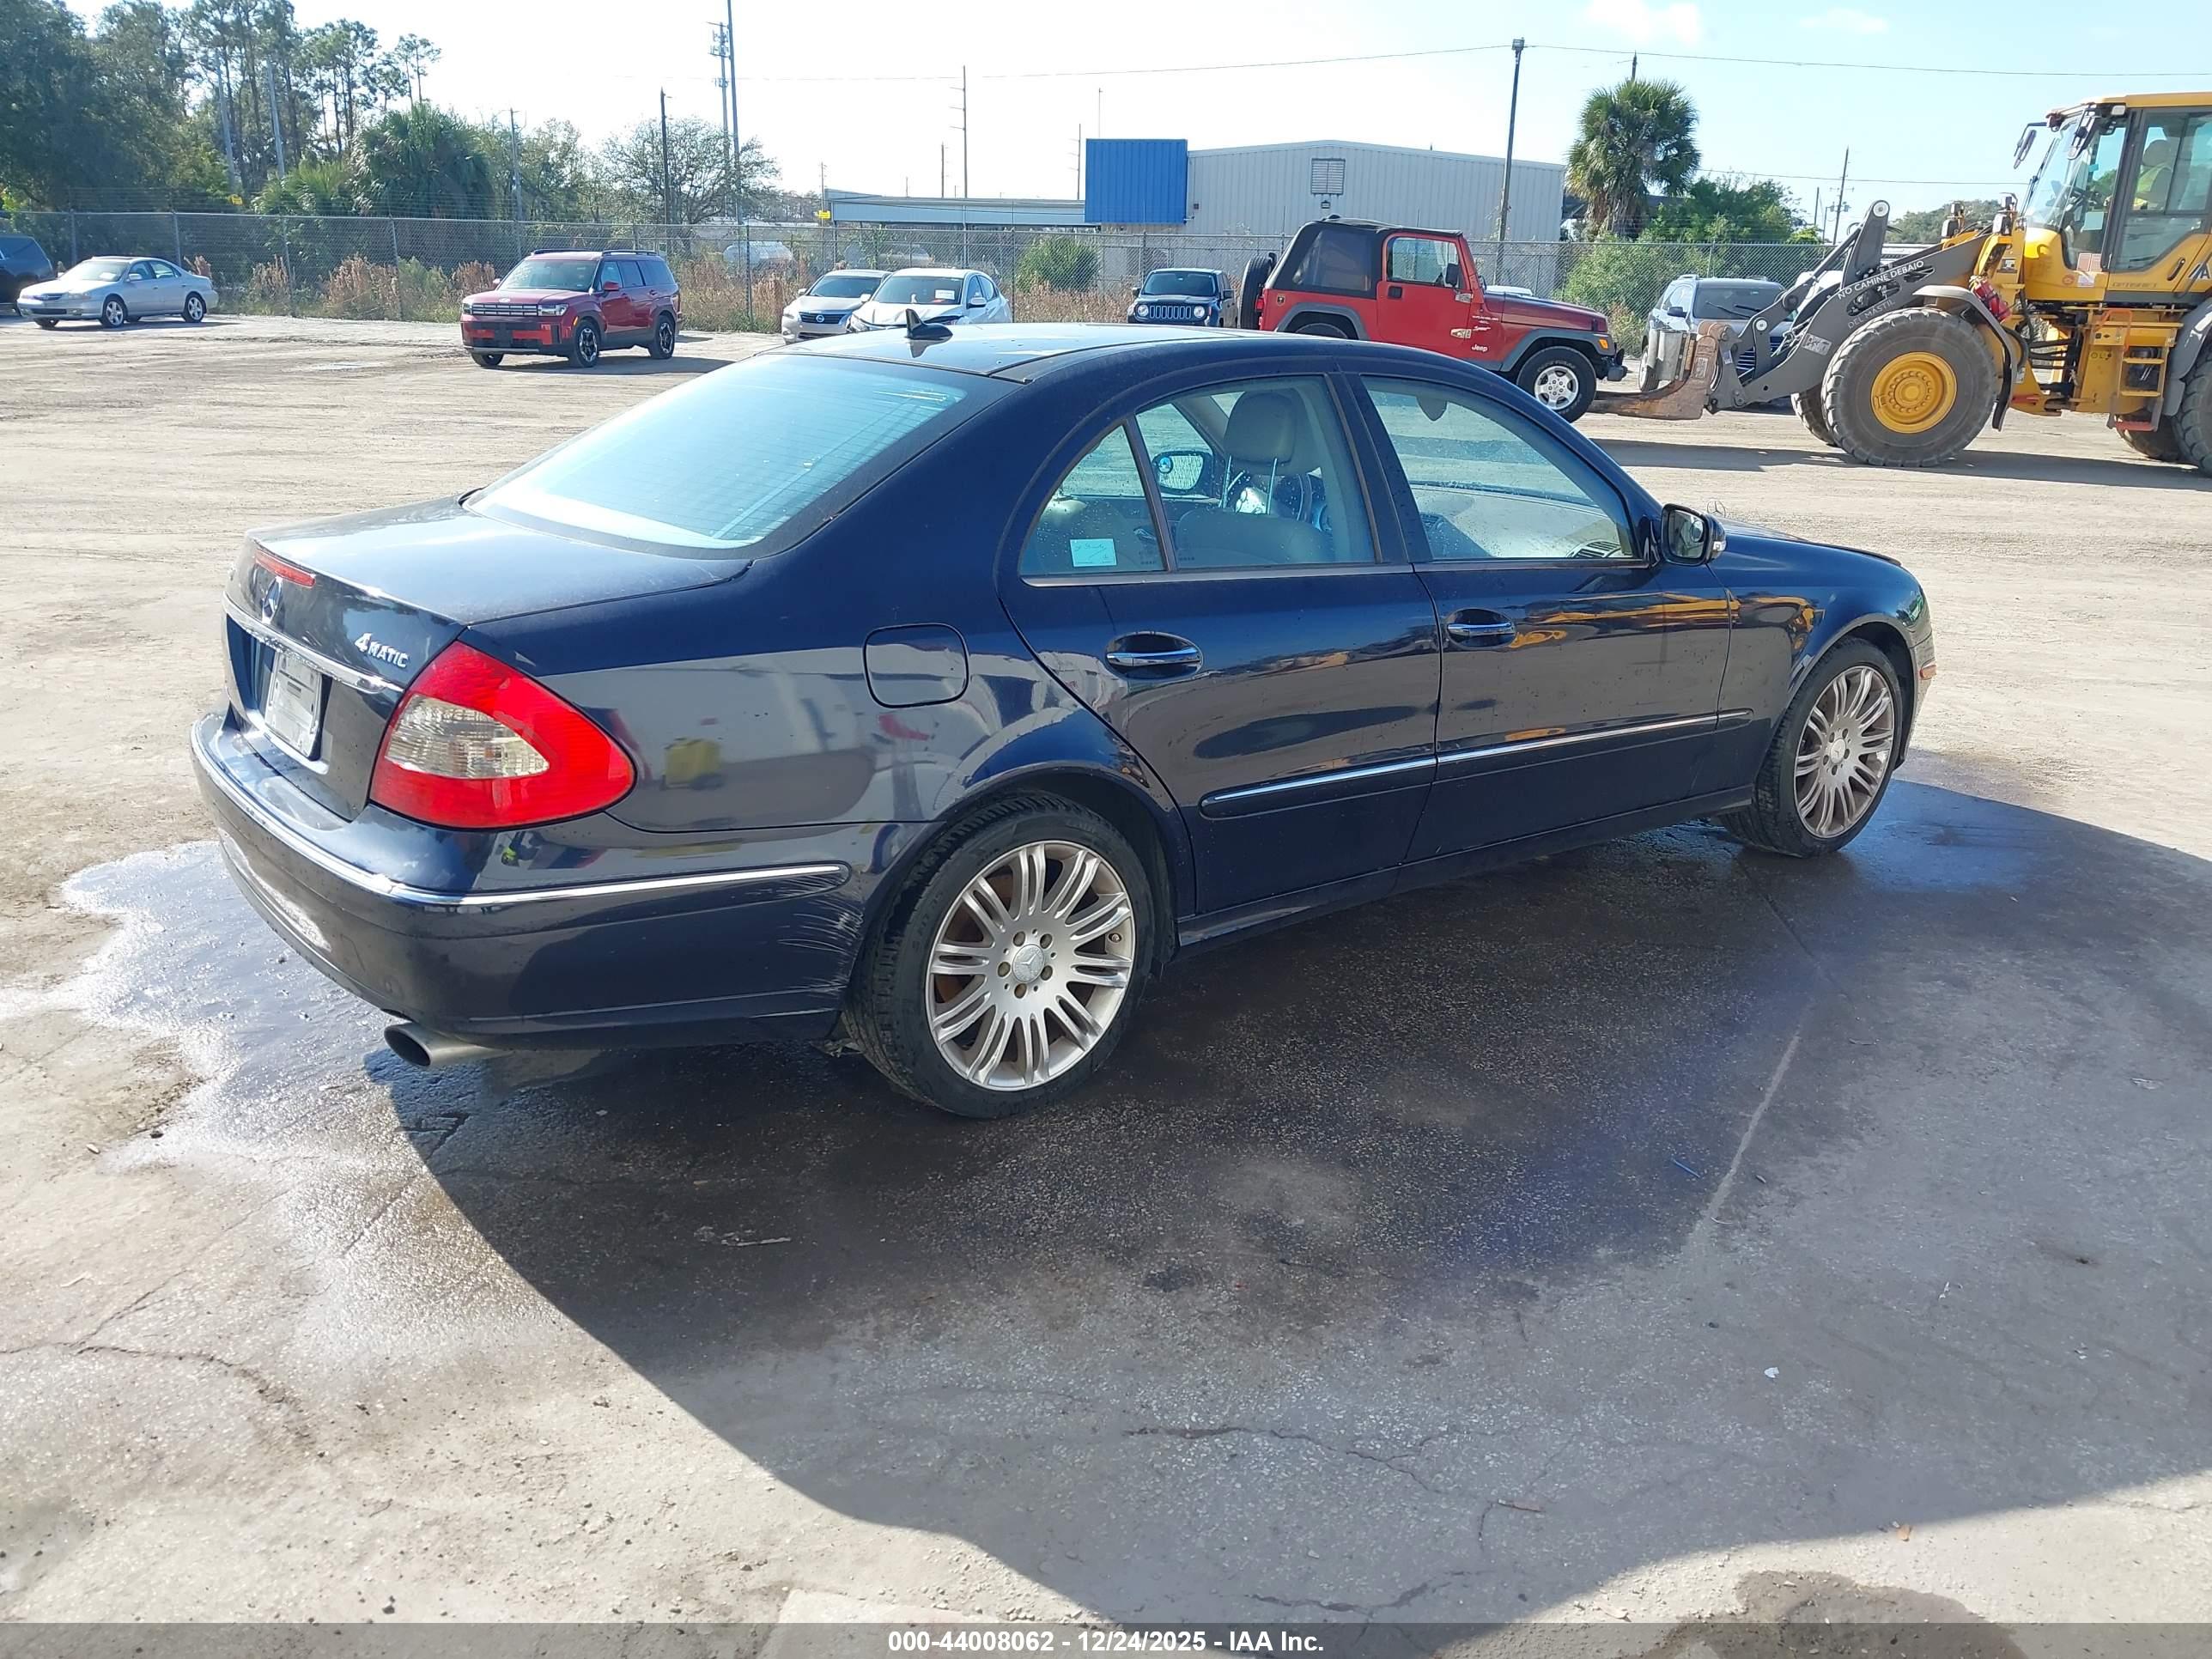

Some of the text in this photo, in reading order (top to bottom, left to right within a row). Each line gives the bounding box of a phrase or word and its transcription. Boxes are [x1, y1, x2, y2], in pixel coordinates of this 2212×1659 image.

[1838, 287, 1853, 301] NO
[1854, 273, 1890, 292] CAMINE
[1847, 299, 1896, 330] DEL MASTIL
[1471, 343, 1488, 352] Jeep
[354, 632, 409, 668] 4MATIC
